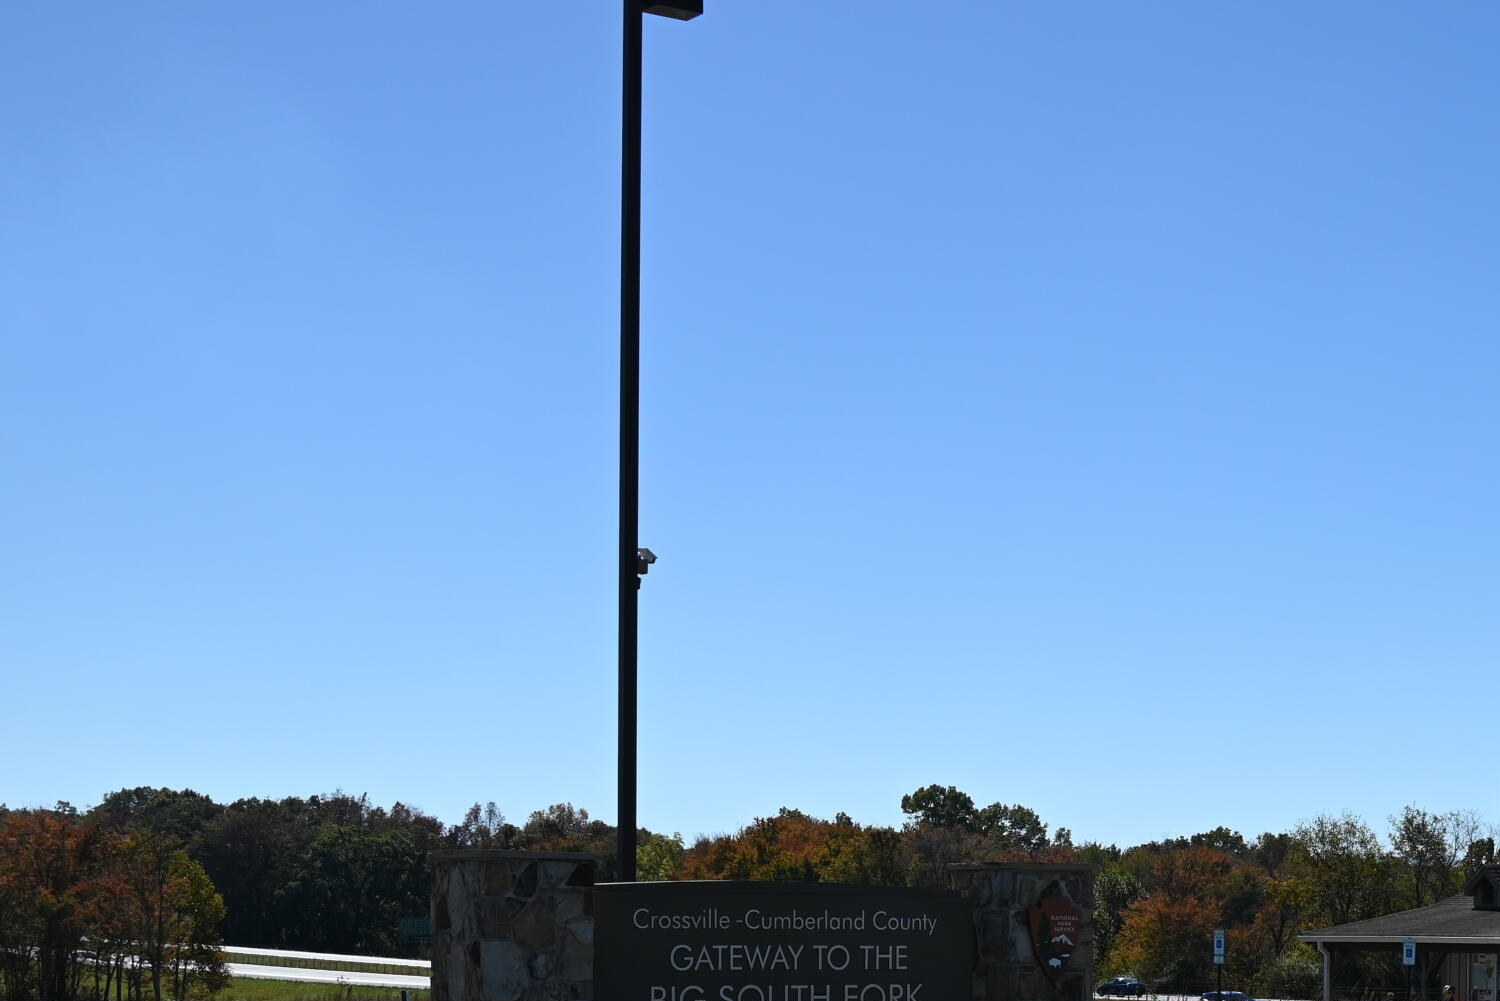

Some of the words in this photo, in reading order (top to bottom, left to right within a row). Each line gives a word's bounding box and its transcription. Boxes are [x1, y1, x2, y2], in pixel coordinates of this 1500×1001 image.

[872, 911, 938, 936] County
[670, 943, 804, 972] GATEWAY
[813, 944, 850, 971] TO
[860, 945, 908, 970] THE
